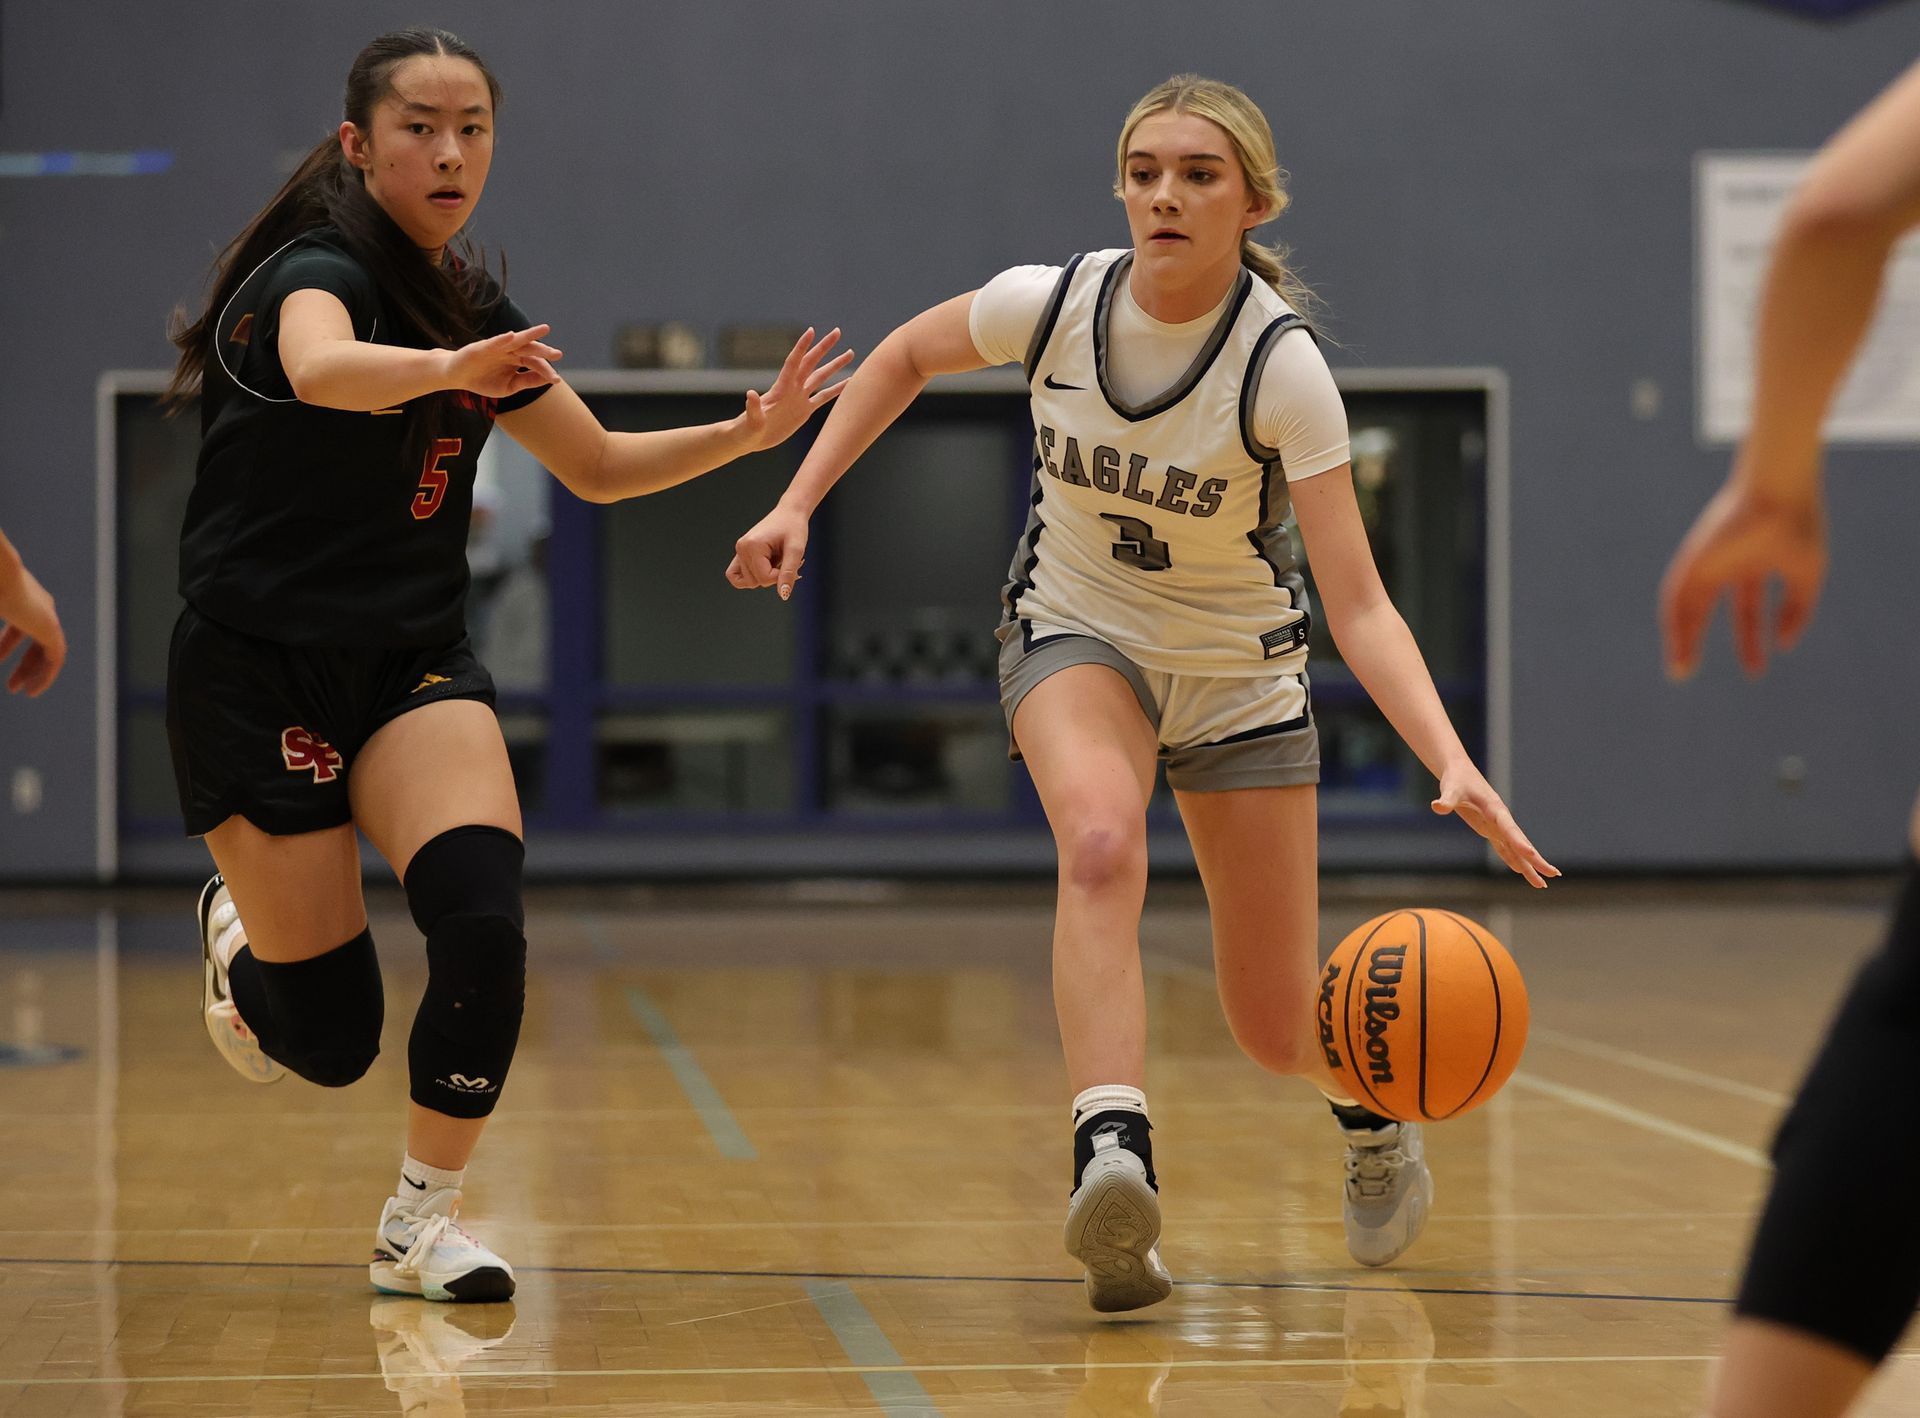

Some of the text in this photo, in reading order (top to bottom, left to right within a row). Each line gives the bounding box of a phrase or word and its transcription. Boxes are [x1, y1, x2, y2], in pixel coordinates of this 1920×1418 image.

[410, 437, 462, 520] 5
[1040, 423, 1228, 518] EAGLES
[1099, 511, 1172, 571] 3
[1298, 628, 1305, 640] S
[1318, 963, 1344, 1070] NCAA
[1364, 944, 1408, 1084] Wilson
